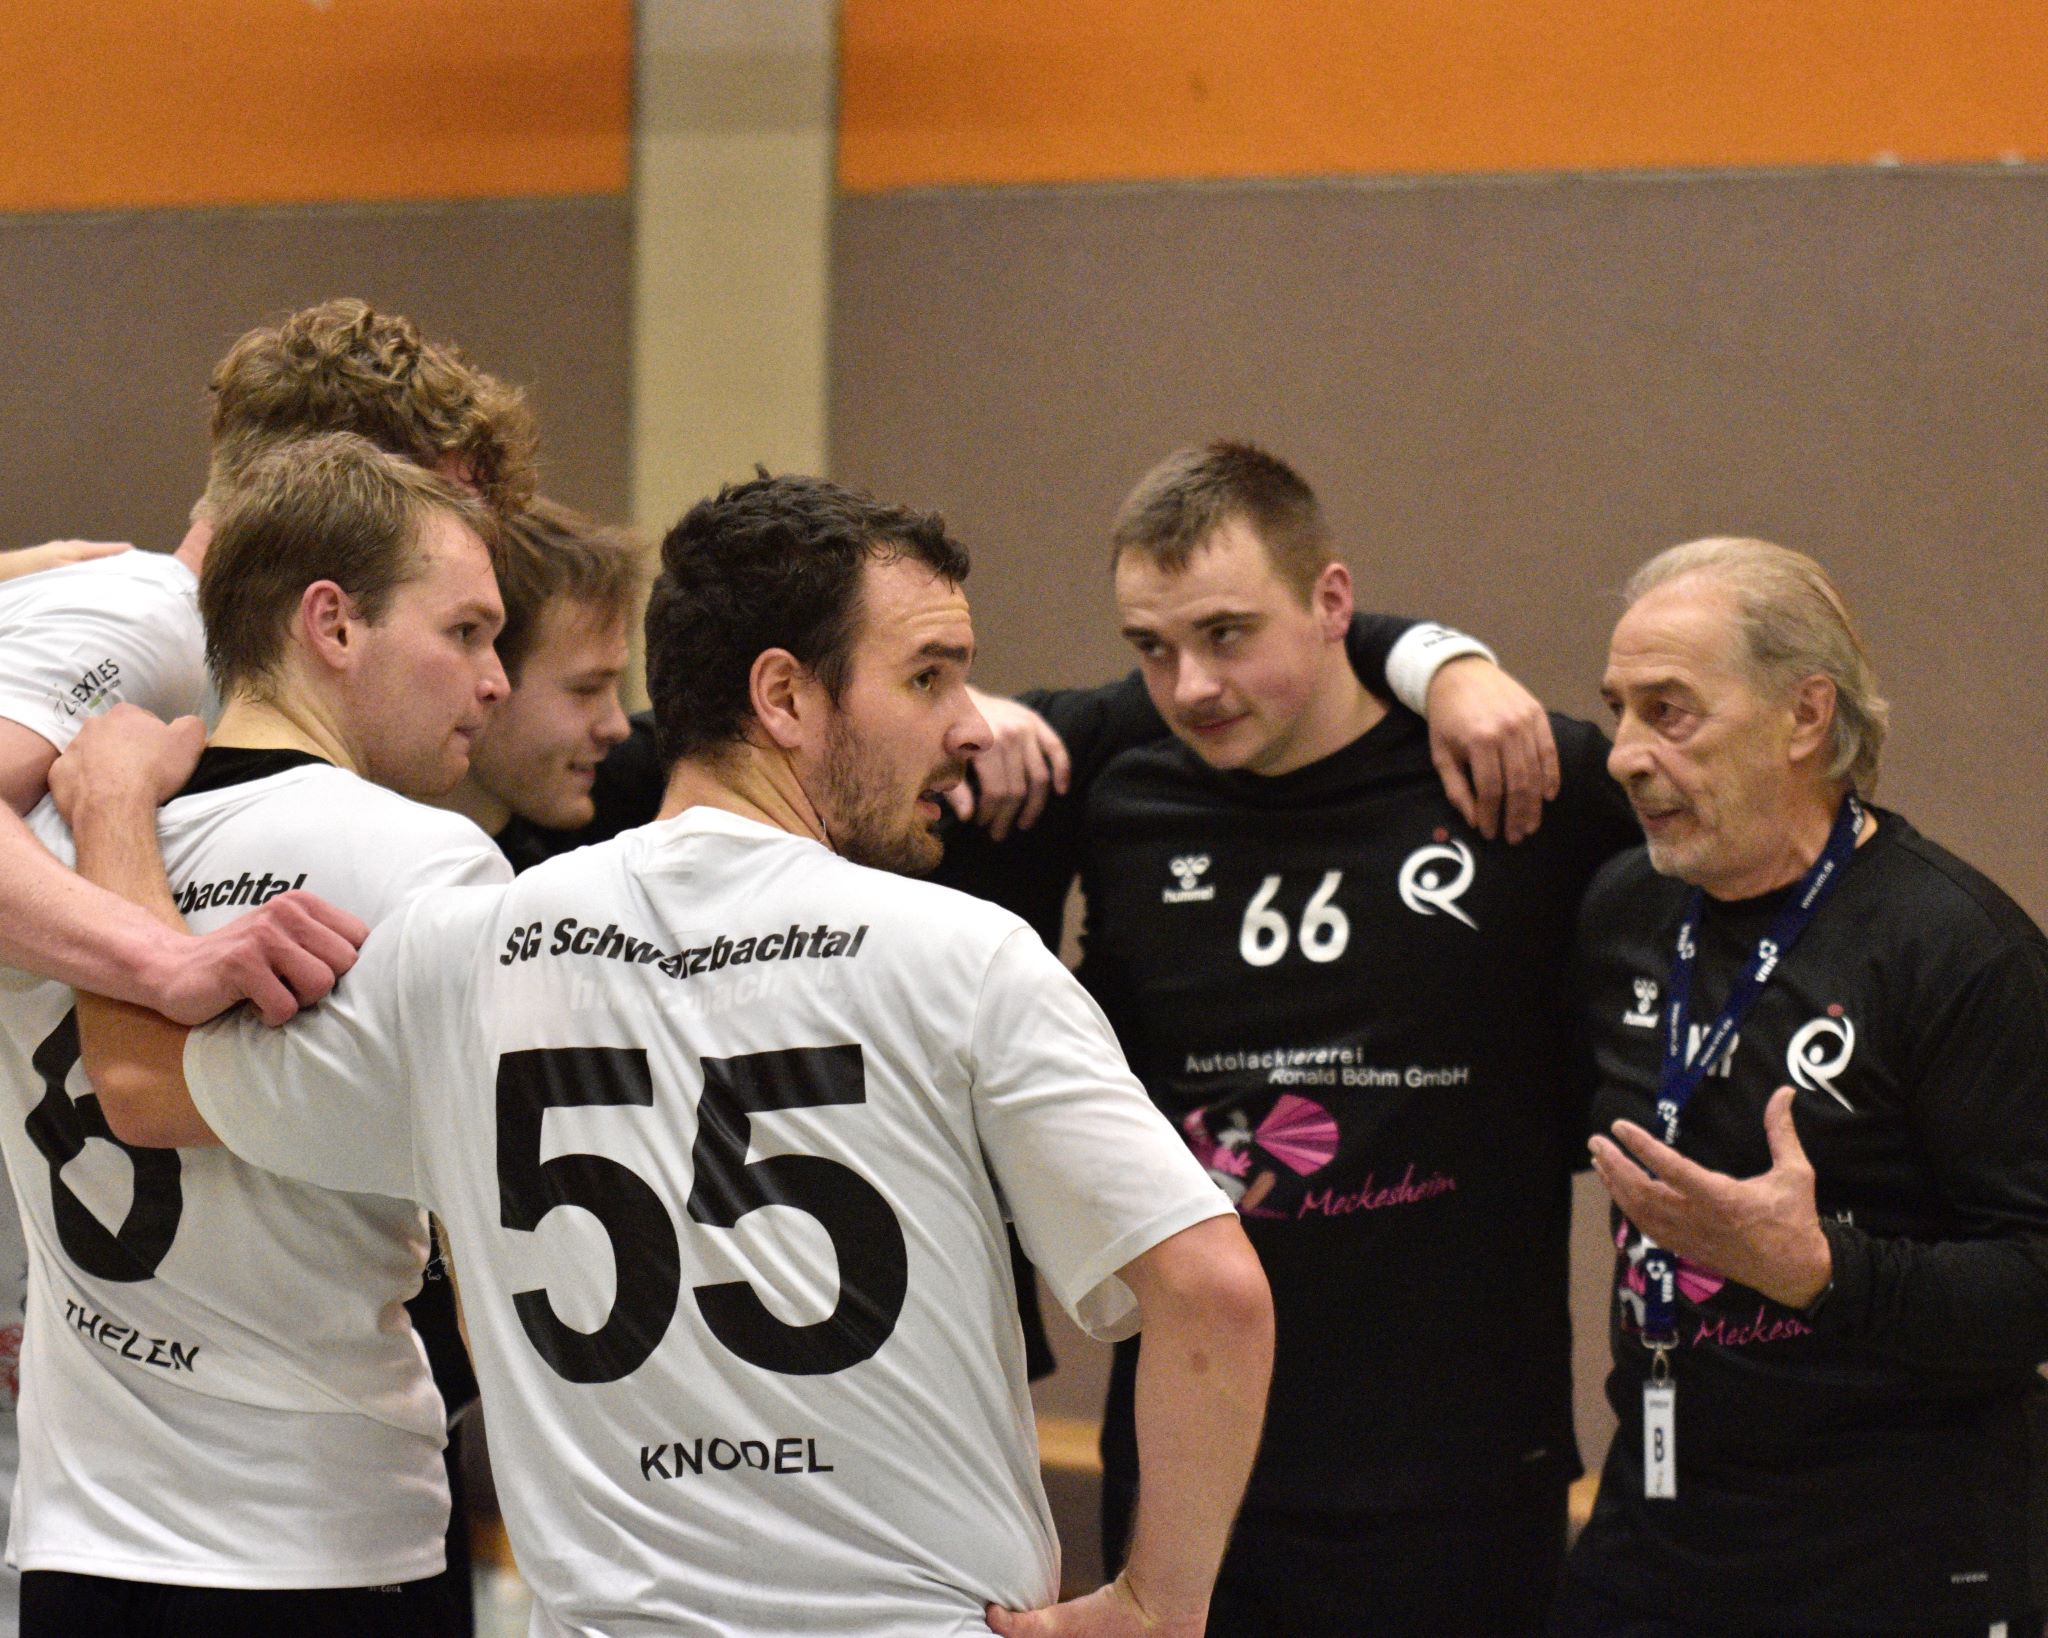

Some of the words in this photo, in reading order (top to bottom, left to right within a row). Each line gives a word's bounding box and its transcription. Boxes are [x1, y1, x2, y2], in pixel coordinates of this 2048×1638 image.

[500, 922, 543, 966] SG
[551, 918, 869, 980] Schwarzbachtal
[1239, 871, 1350, 967] 66
[1754, 955, 1779, 983] VRN
[1341, 1065, 1399, 1088] Böhm
[1404, 1065, 1469, 1088] GmbH
[495, 1043, 908, 1384] 55
[66, 1299, 200, 1374] THELEN
[640, 1437, 834, 1482] KNODEL
